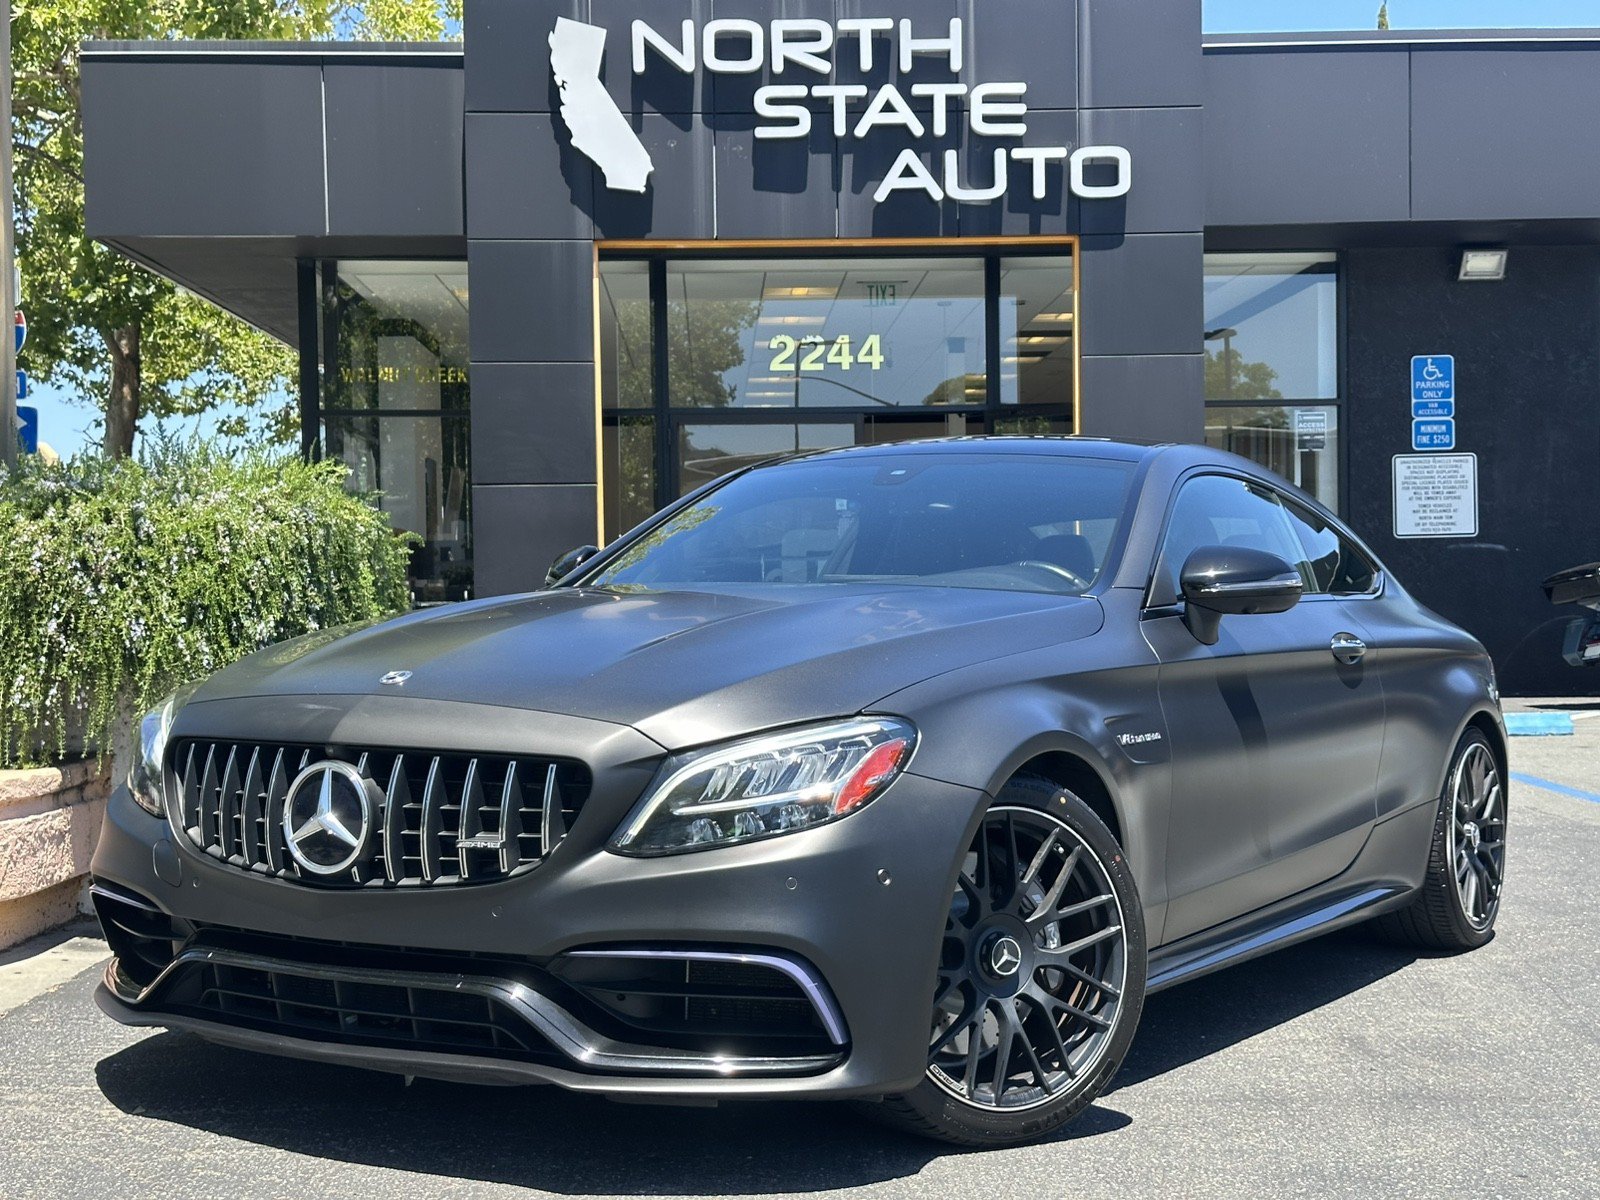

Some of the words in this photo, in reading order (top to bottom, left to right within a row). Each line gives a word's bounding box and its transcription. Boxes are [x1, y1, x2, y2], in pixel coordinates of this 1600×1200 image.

[631, 17, 963, 75] NORTH
[753, 82, 1028, 140] STATE
[873, 145, 1132, 203] AUTO
[769, 334, 884, 371] 2244
[1415, 380, 1450, 389] PARKING
[1422, 390, 1443, 399] ONLY
[1416, 435, 1431, 444] FINE
[1433, 434, 1450, 444] $250
[1420, 424, 1447, 433] MINIMUM
